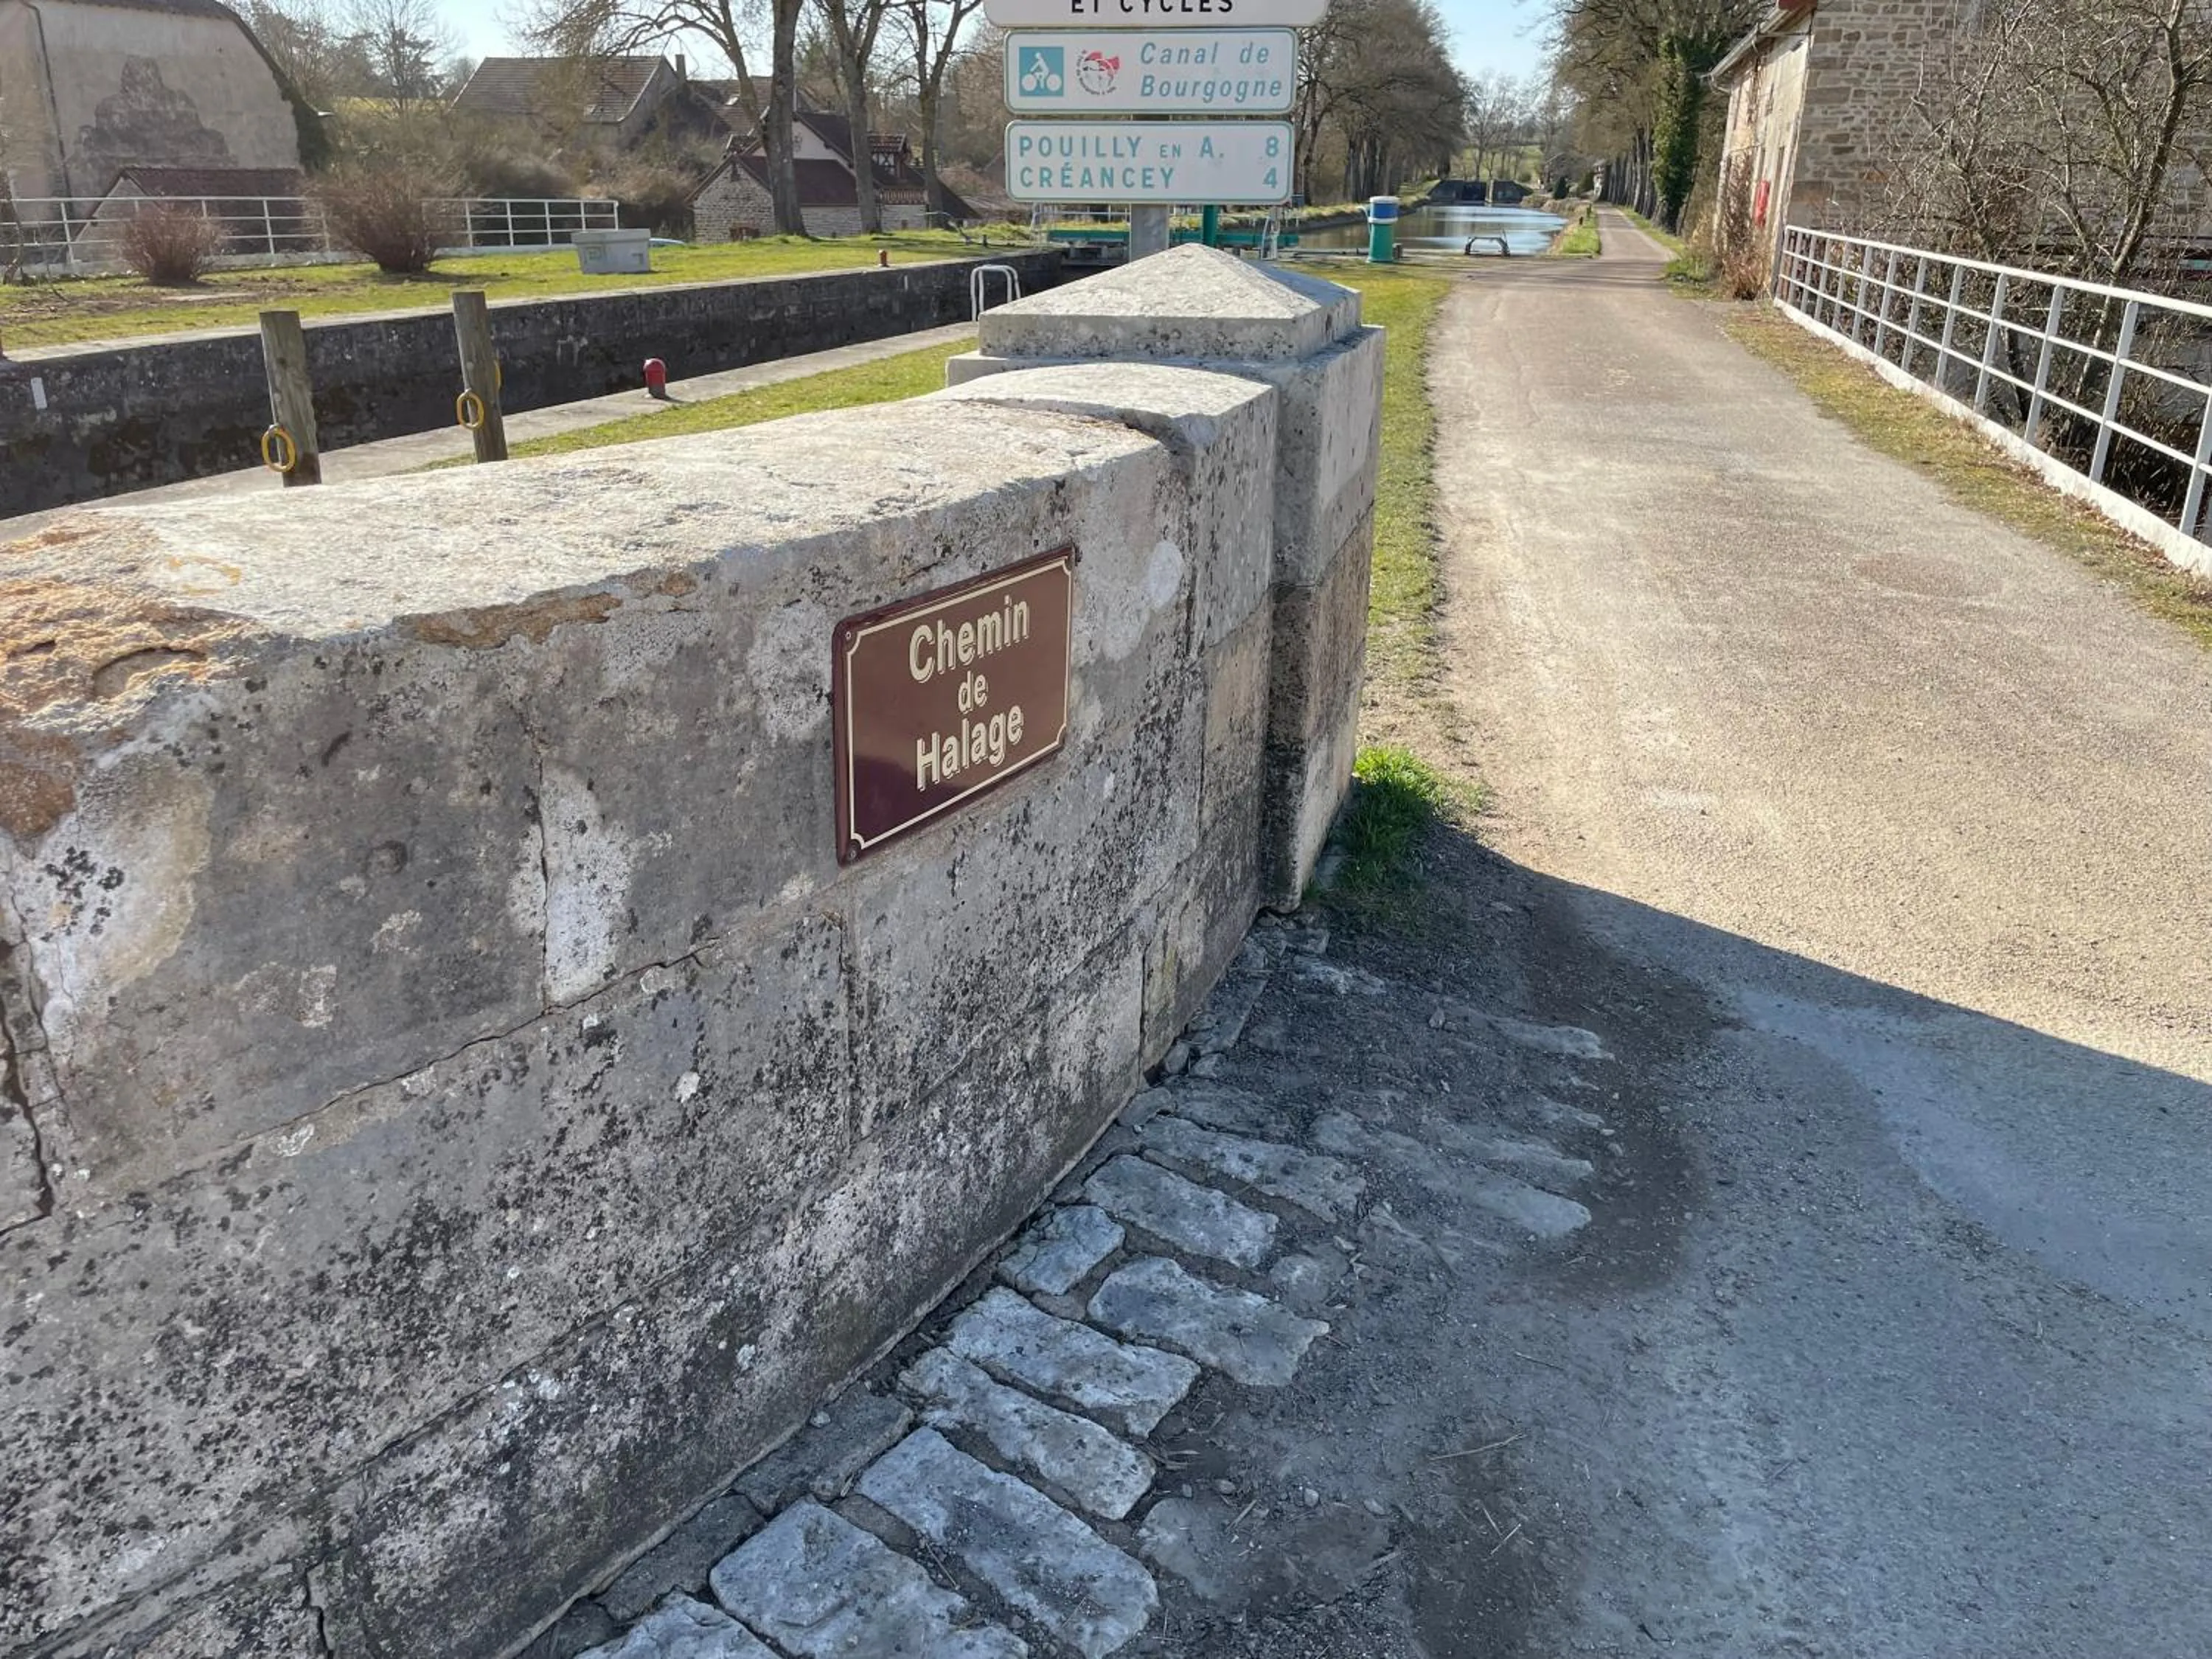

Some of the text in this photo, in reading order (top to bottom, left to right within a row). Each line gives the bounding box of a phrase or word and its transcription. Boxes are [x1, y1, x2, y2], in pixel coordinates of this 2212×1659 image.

[1140, 42, 1269, 65] Canal de
[1140, 76, 1282, 103] Bourgogne
[1019, 136, 1279, 159] POUILLY EN A. 8
[1020, 162, 1278, 189] CRÉANCEY 4
[909, 594, 1031, 684] Chemin
[958, 671, 988, 715] de
[917, 705, 1024, 793] Halage
